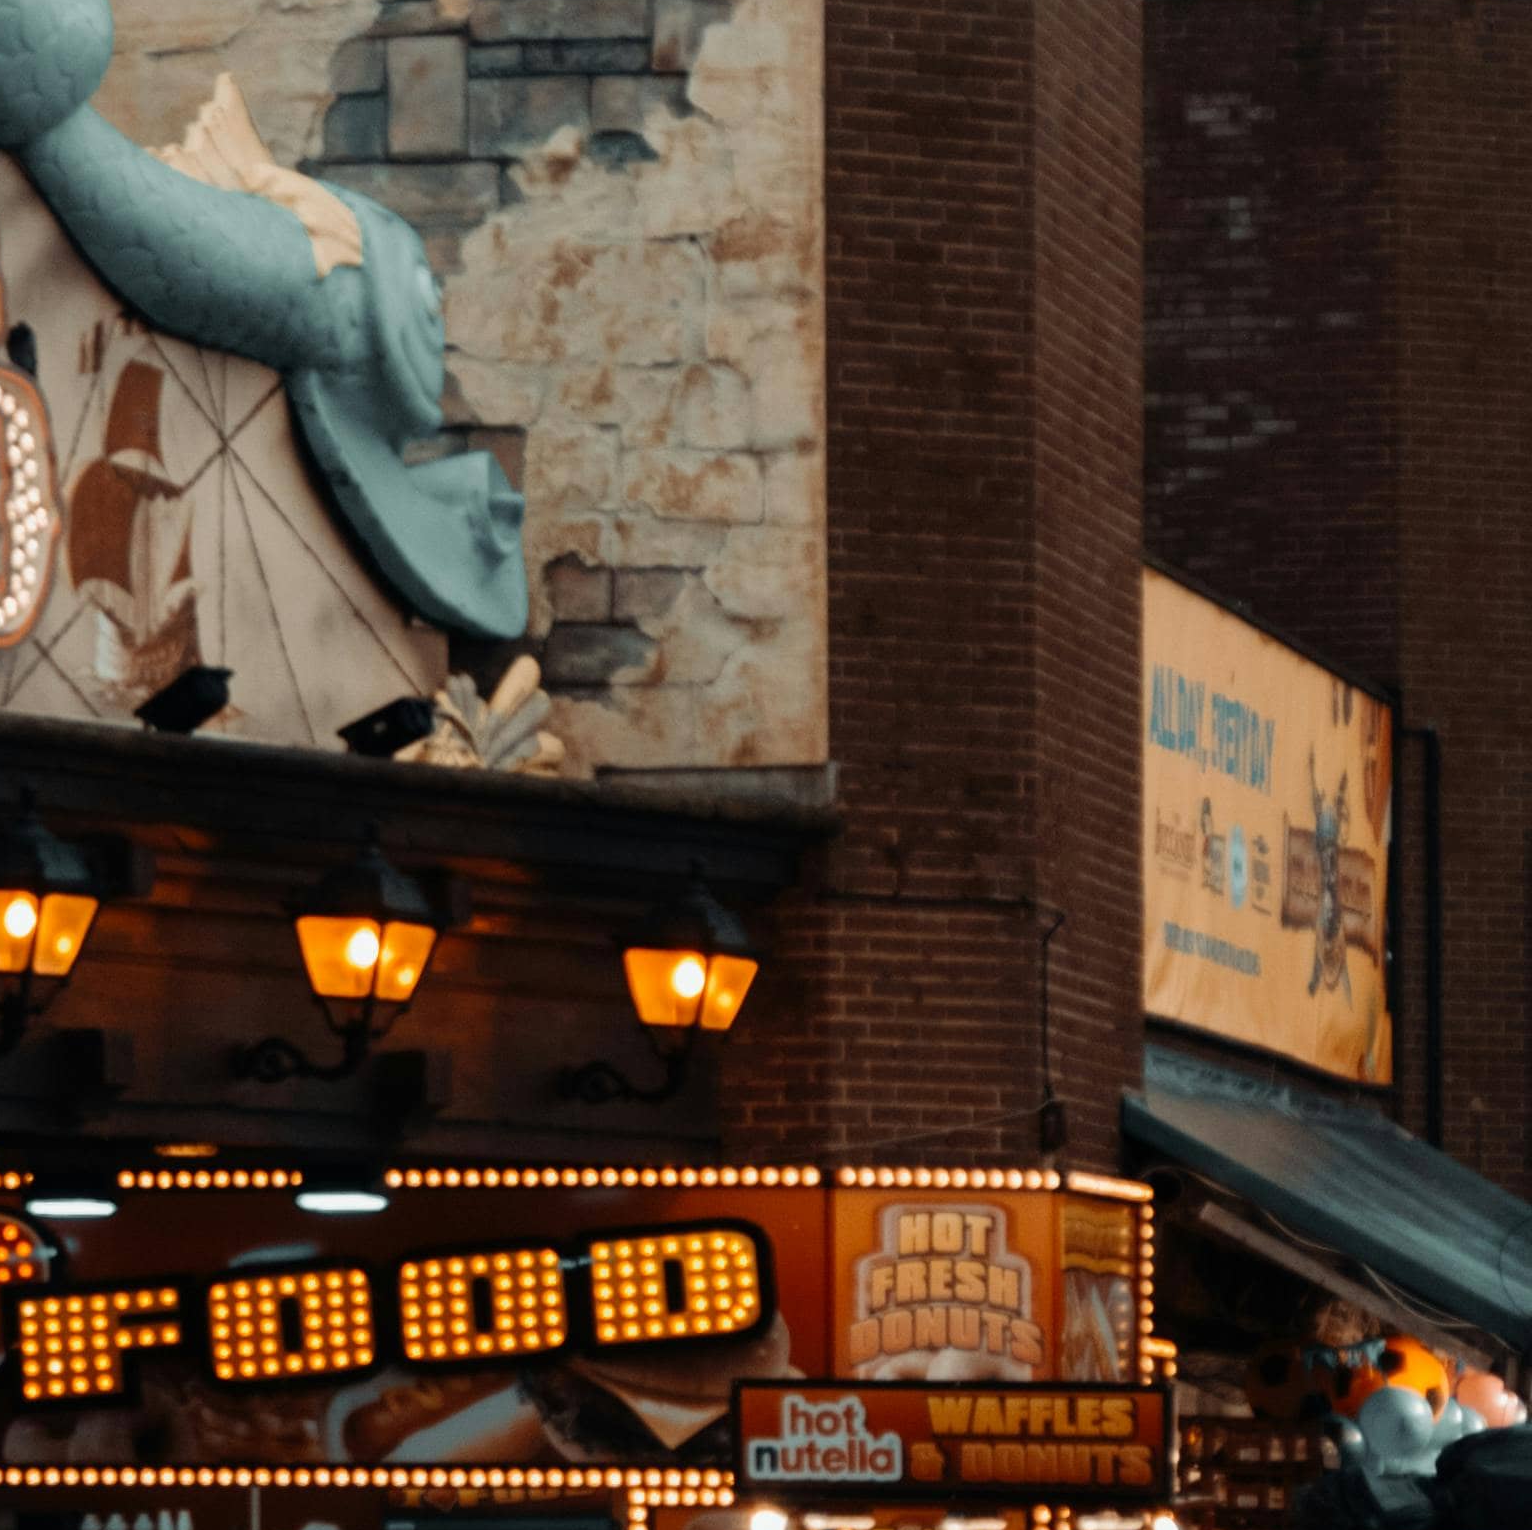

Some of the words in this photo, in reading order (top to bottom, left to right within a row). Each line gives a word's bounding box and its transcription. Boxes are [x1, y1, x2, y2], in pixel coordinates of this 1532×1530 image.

[898, 1212, 993, 1257] HOT
[868, 1259, 1021, 1314] FRESH
[18, 1229, 764, 1401] FOOD
[849, 1307, 1045, 1366] DONUTS
[789, 1400, 858, 1436] hot
[927, 1396, 1135, 1437] WAFFLES
[754, 1436, 896, 1474] nutella
[910, 1442, 944, 1482] &
[961, 1442, 1155, 1486] DONUTS
